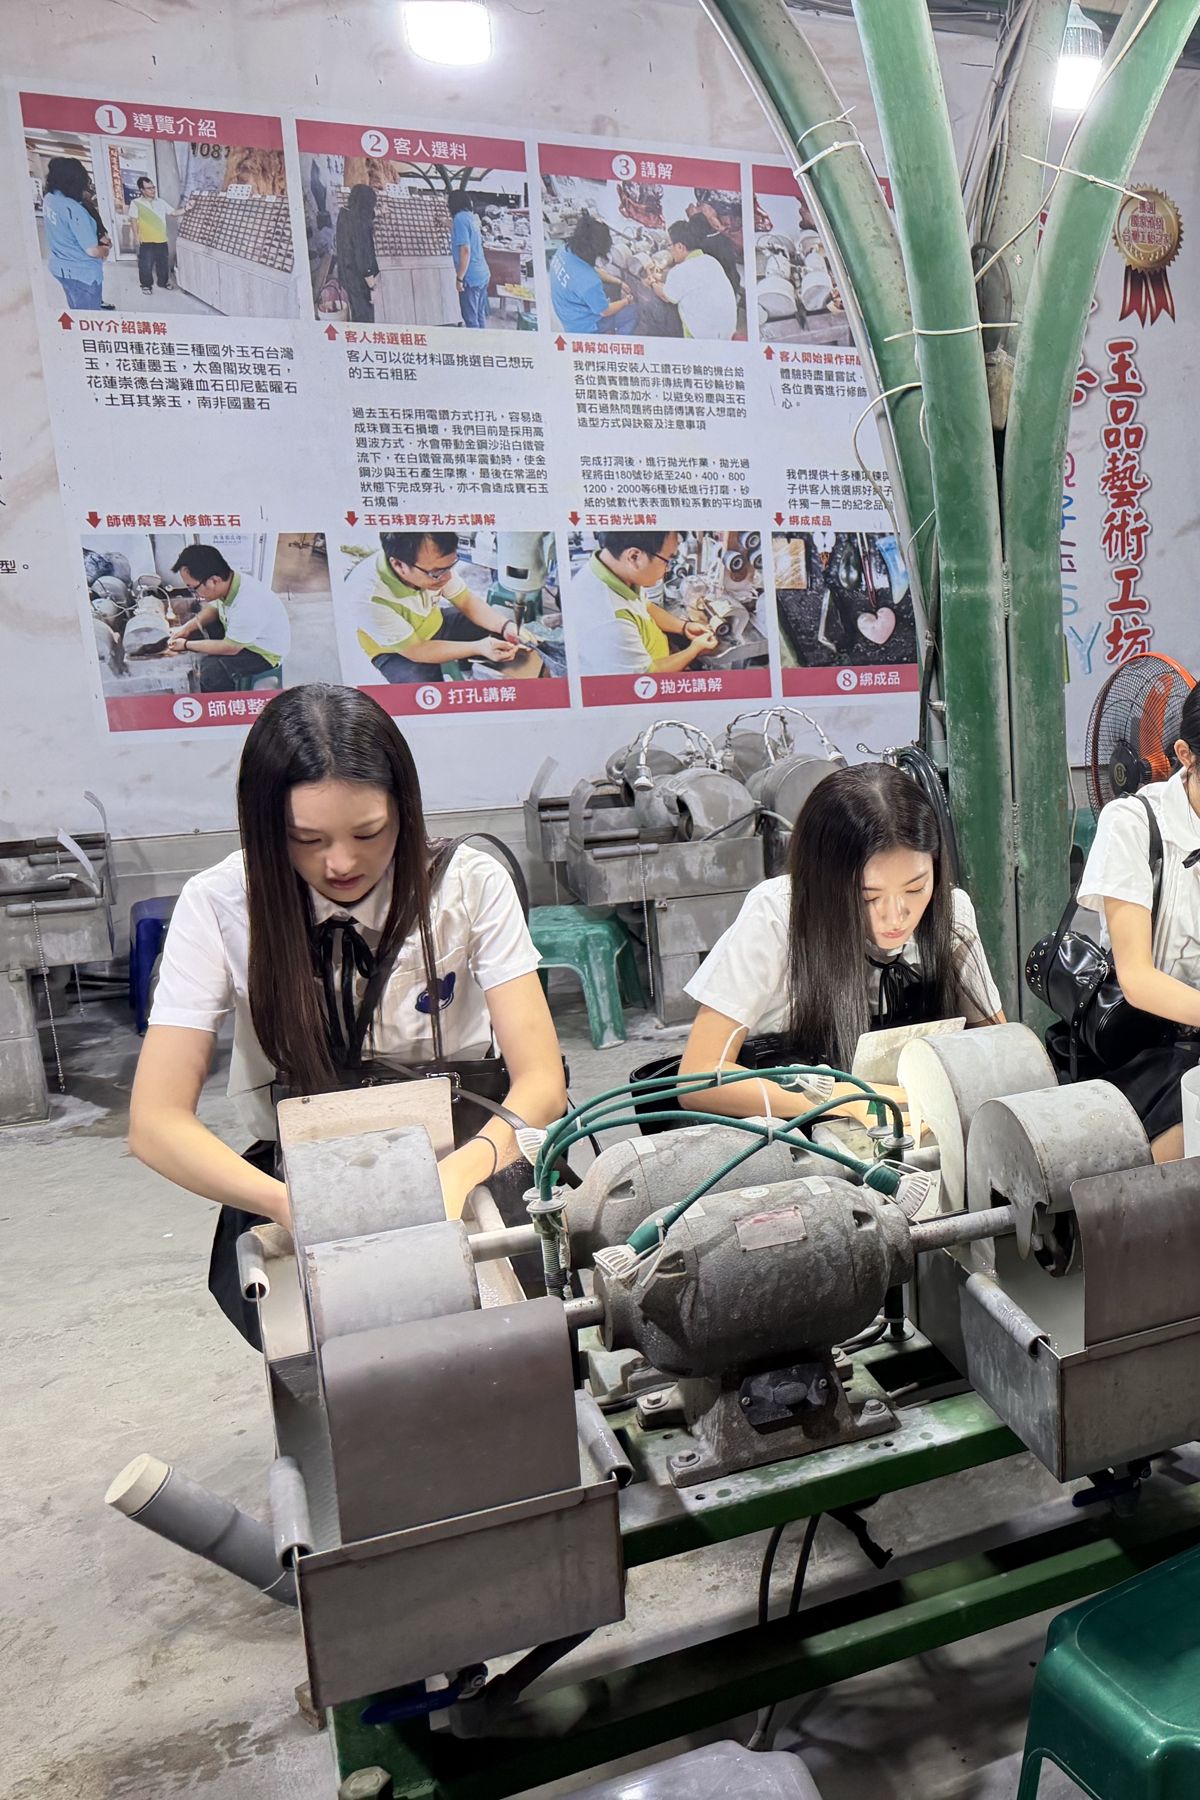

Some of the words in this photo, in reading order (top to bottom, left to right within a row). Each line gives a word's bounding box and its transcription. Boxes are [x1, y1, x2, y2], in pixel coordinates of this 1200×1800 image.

[133, 112, 217, 138] 導覽介紹
[393, 136, 468, 161] 客人選料
[640, 161, 673, 180] 講解
[79, 319, 168, 336] DIY介紹講解
[344, 330, 428, 347] 客人挑選粗胚
[82, 339, 294, 361] 目前四種花蓮三種國外玉石台灣
[572, 341, 645, 356] 講解如何研磨
[347, 349, 534, 370] 客人可以從材料區挑選自己想玩
[348, 366, 417, 381] 的玉石粗胚
[363, 513, 497, 527] 玉石珠寶穿孔方式講解
[585, 513, 657, 527] 玉石拋光講解
[789, 515, 832, 527] 綁成成品
[660, 677, 723, 694] 拋光講解
[859, 671, 901, 687] 綁成品
[448, 686, 518, 704] 打孔講解
[207, 698, 272, 717] 師傅整
